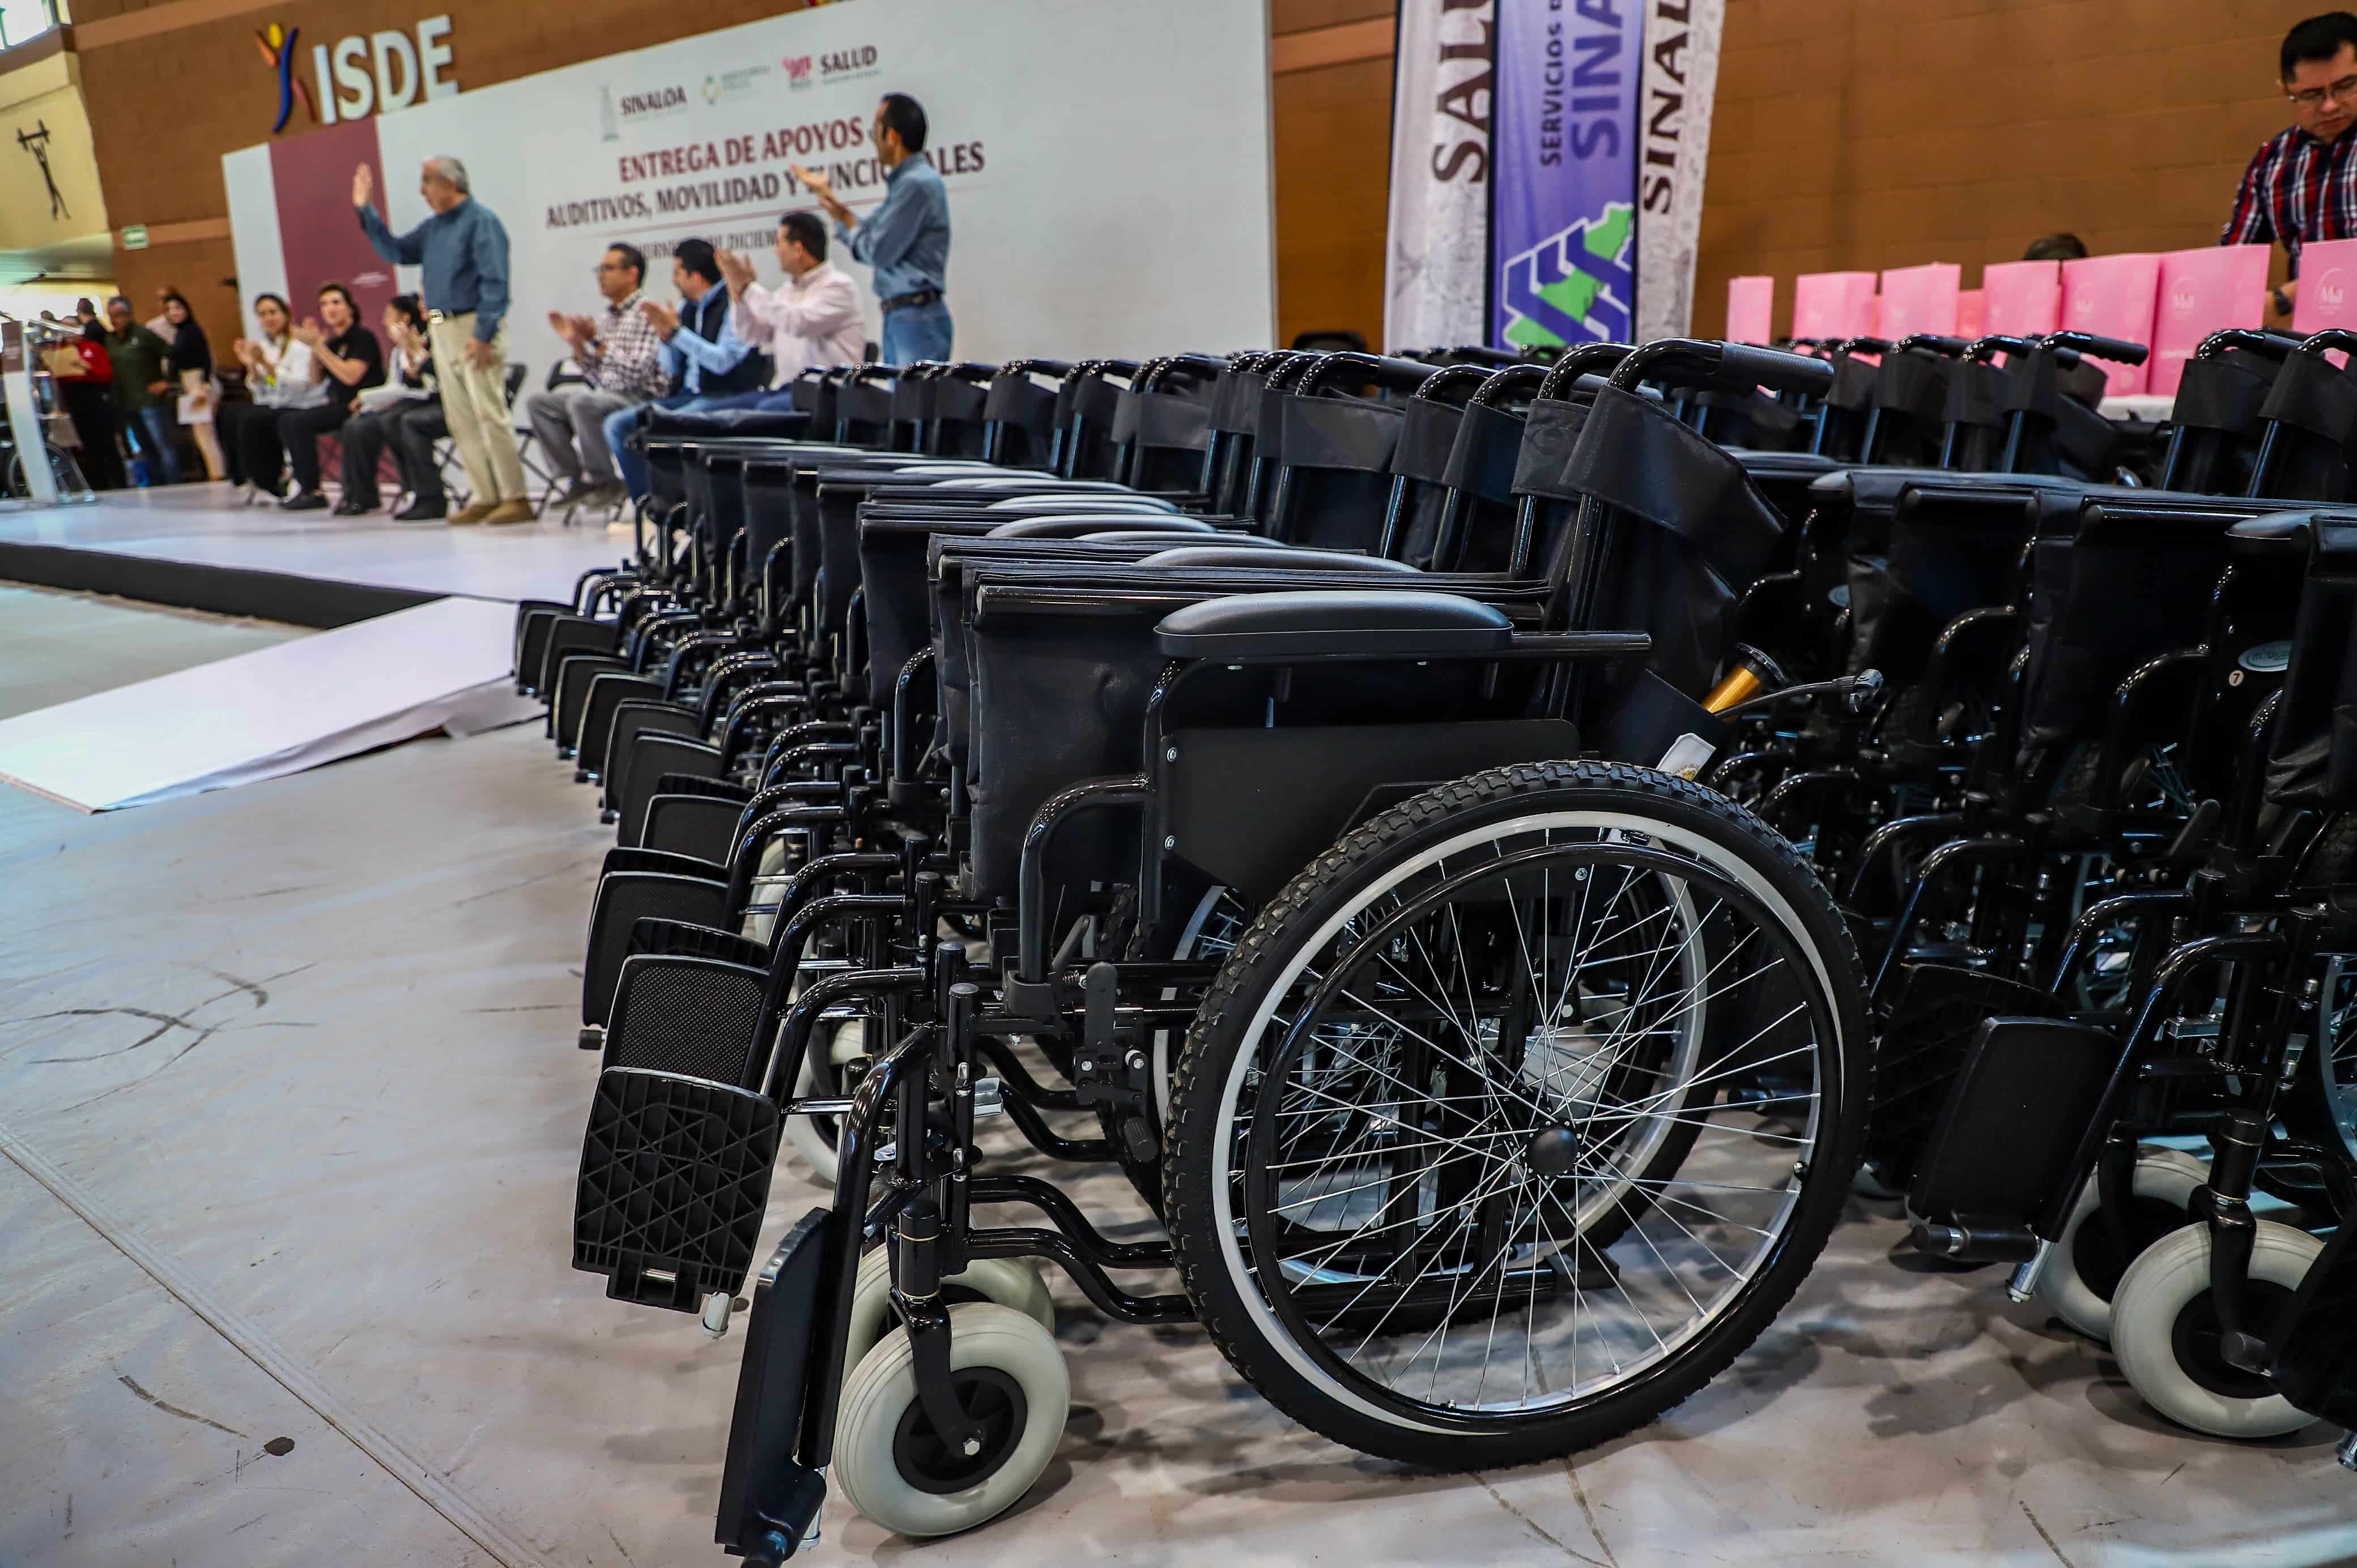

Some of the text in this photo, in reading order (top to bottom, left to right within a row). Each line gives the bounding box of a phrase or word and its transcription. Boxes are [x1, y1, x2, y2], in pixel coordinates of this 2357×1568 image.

[312, 14, 458, 124] ISDE
[820, 45, 878, 75] SALUD
[620, 84, 687, 116] SINALOA
[1541, 22, 1564, 167] SERVICIOS
[619, 116, 865, 183] ENTREGA DE APOYOS
[547, 191, 652, 229] AUDITIVOS,
[657, 171, 780, 214] MOVILIDAD
[784, 169, 799, 197] Y
